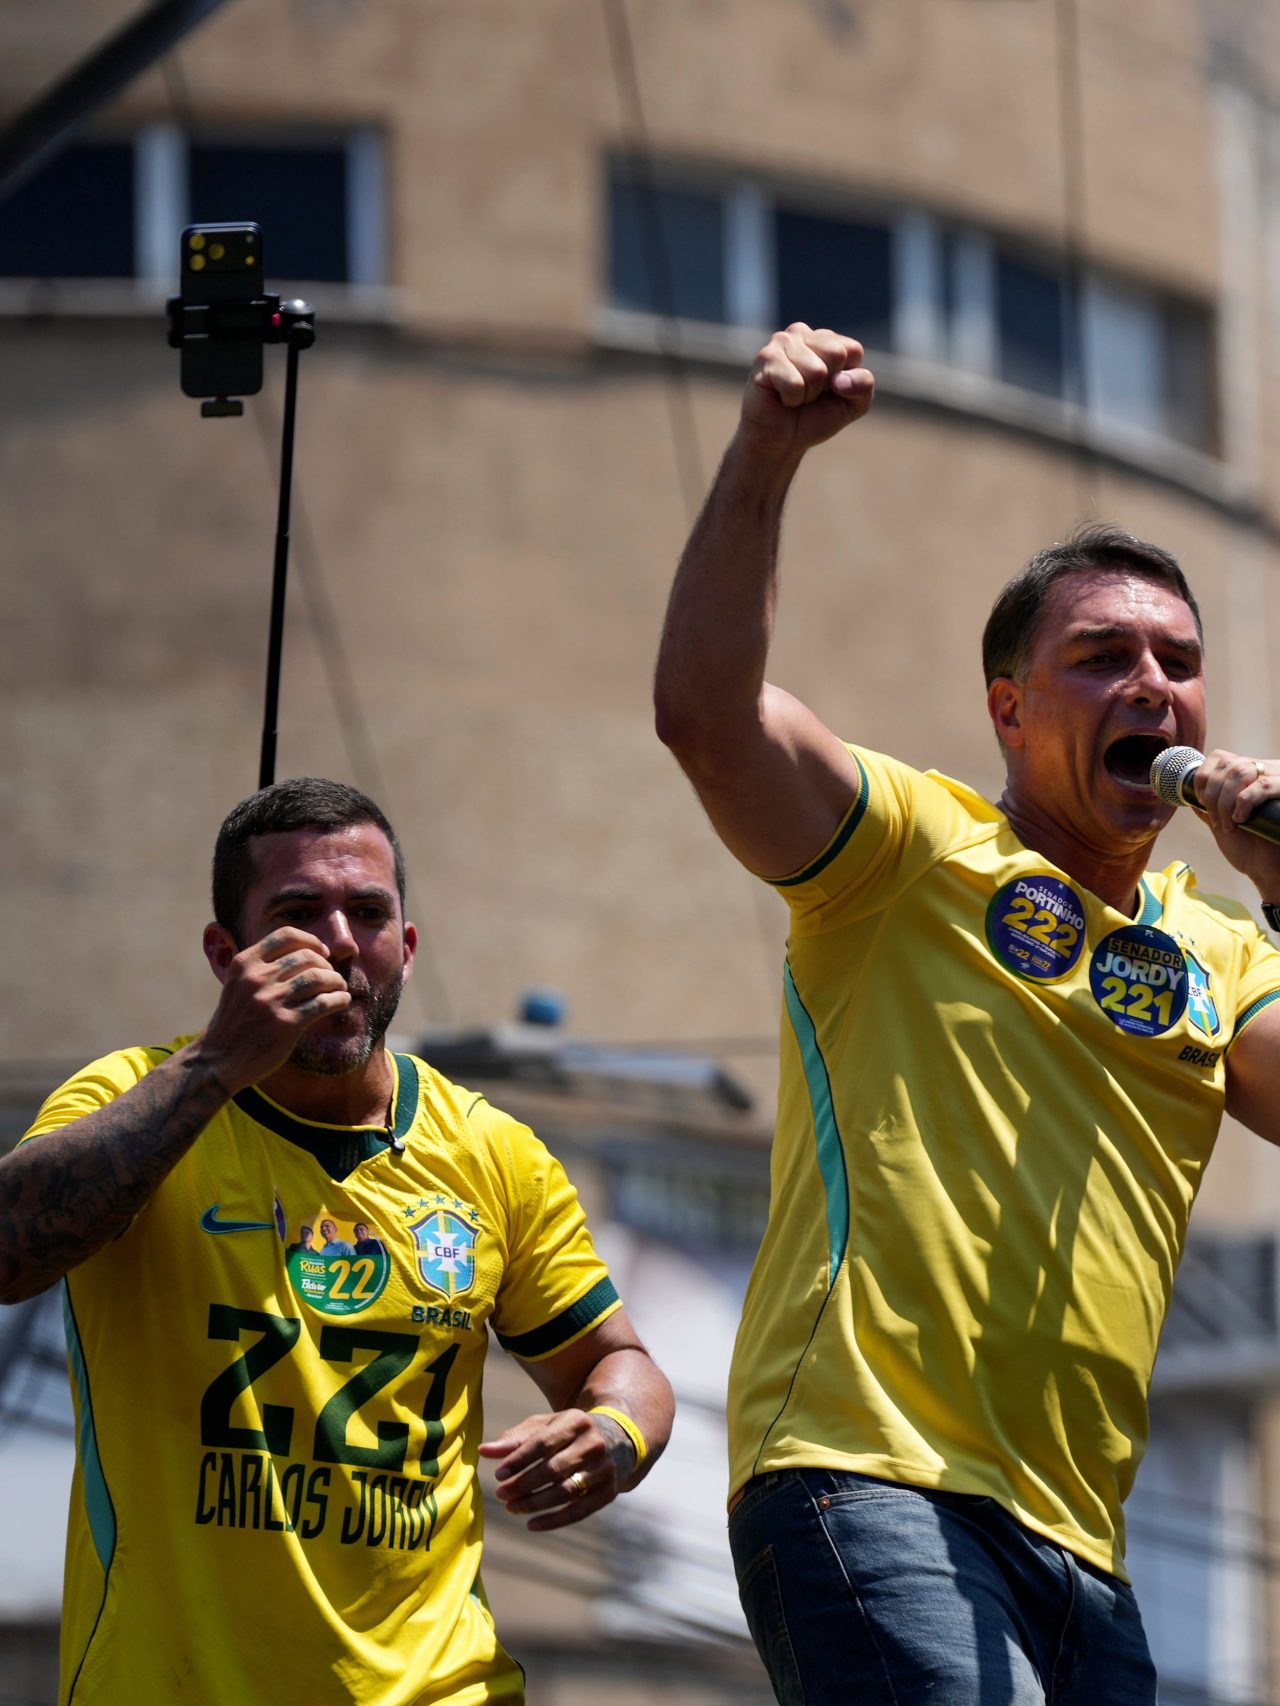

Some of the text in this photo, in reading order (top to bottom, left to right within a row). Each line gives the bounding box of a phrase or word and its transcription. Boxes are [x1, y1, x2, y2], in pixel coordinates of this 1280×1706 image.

[1014, 881, 1085, 931] PORTINHO
[1039, 885, 1074, 909] SENADOR
[1001, 897, 1079, 960] 222
[1096, 952, 1185, 991] JORDY
[1109, 940, 1182, 968] SENADOR
[1100, 976, 1175, 1027] 221
[300, 1259, 326, 1275] Ruas
[434, 1246, 461, 1259] CBF
[328, 1258, 375, 1300] 22
[412, 1305, 472, 1330] BRASIL
[201, 1303, 461, 1478] 221
[195, 1451, 439, 1552] CARLOS JORDY
